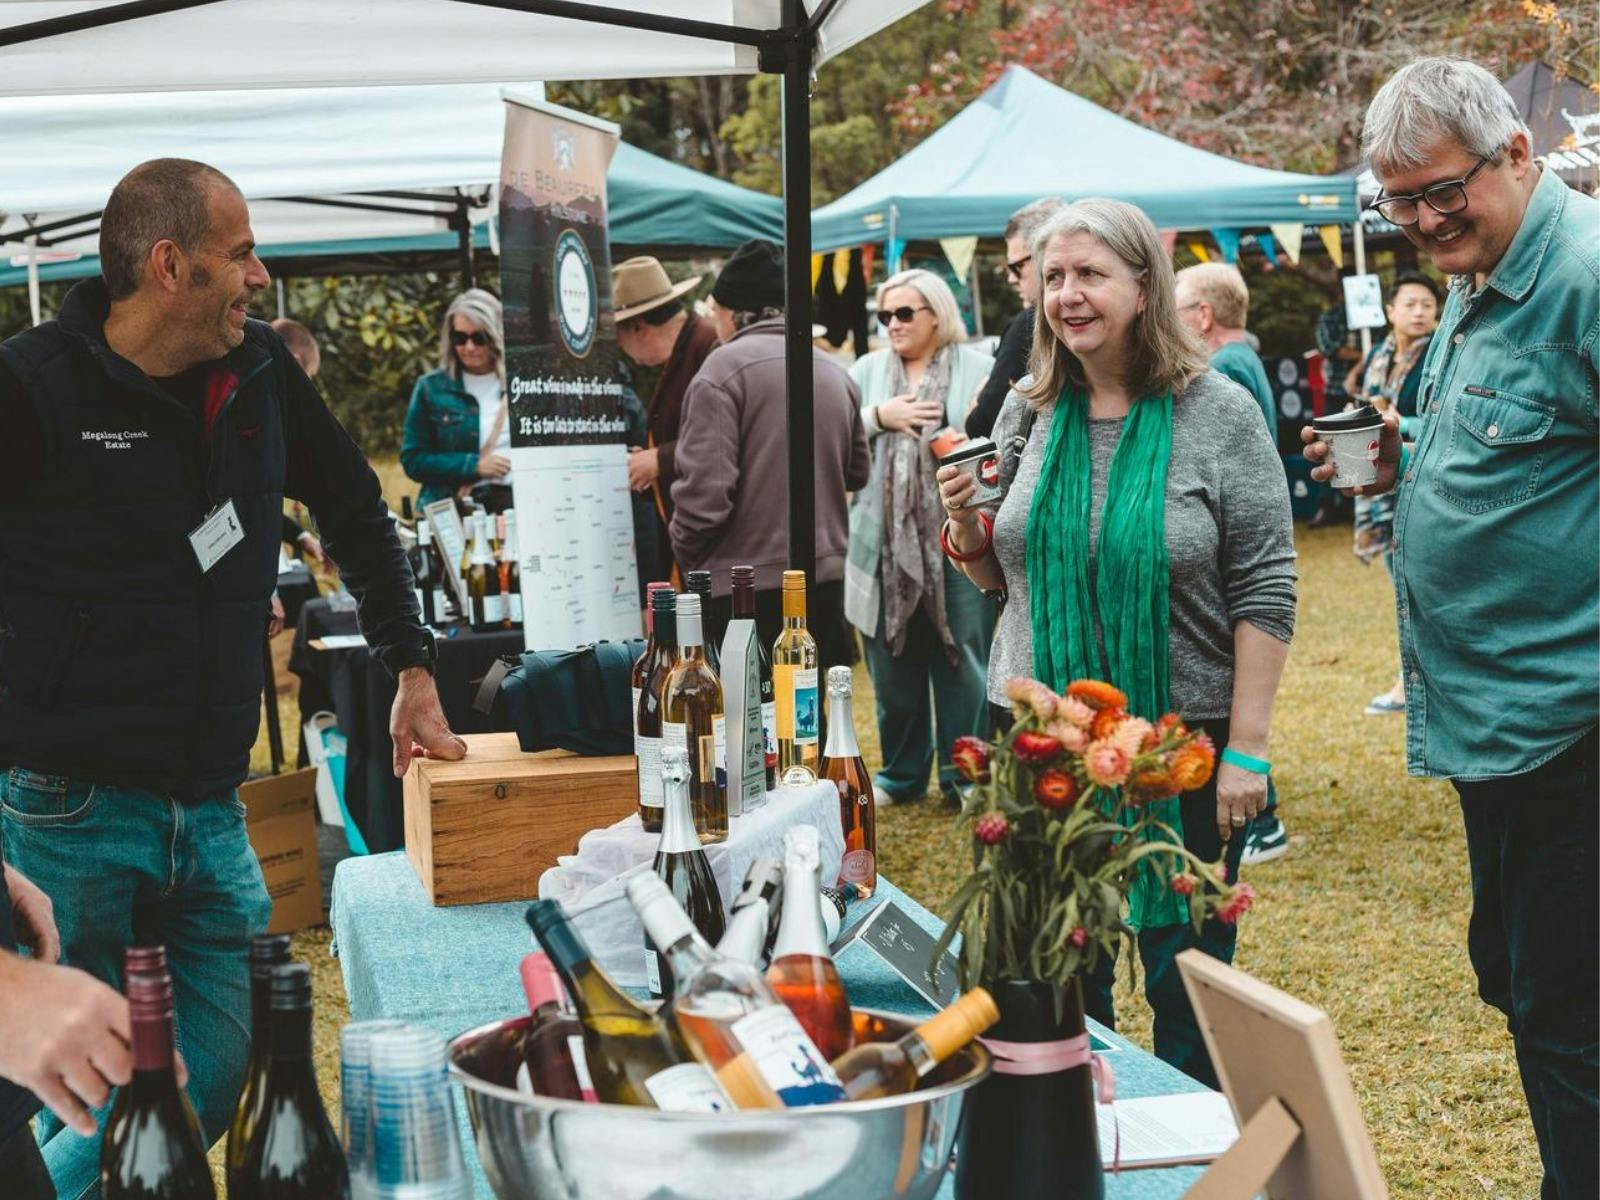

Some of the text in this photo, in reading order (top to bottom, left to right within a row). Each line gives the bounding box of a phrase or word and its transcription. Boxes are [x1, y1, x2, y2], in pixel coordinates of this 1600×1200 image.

[511, 376, 543, 403] Great
[519, 416, 533, 435] It
[533, 415, 542, 434] is
[81, 430, 149, 441] Megalong Creek
[104, 441, 132, 449] Estate
